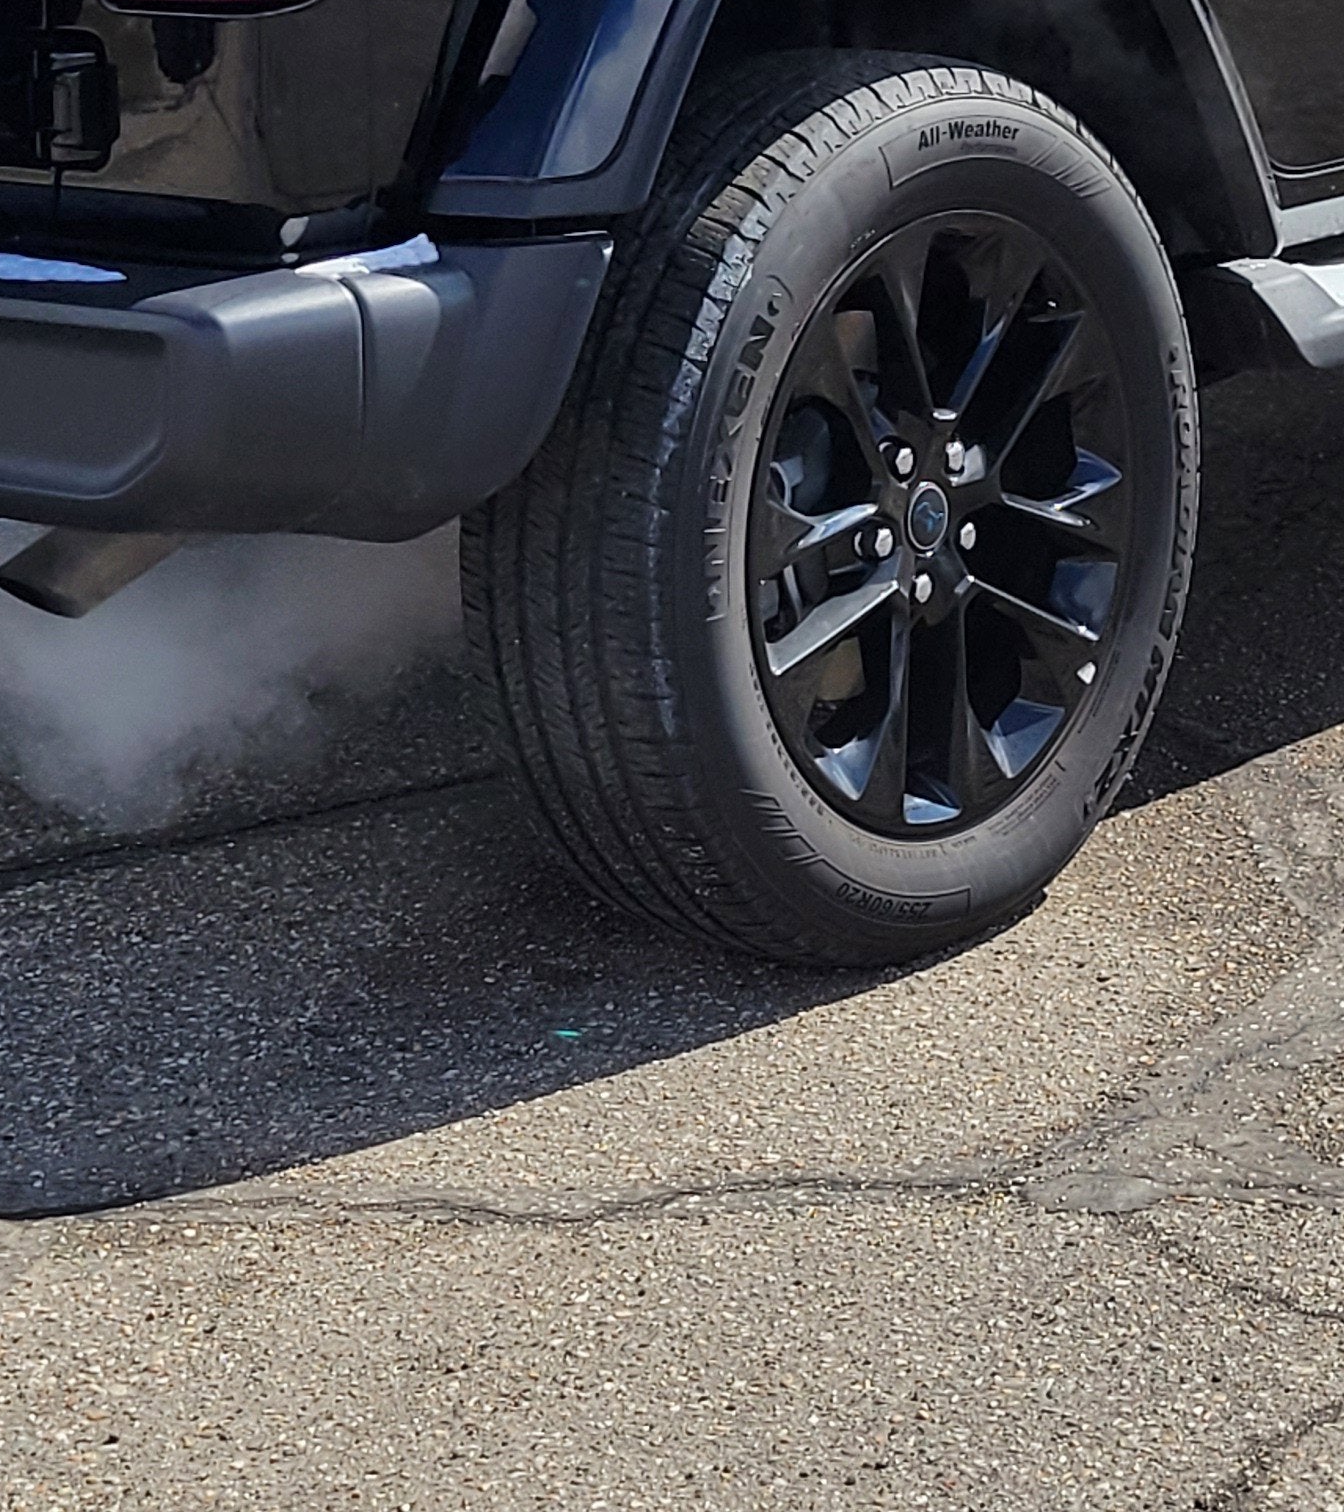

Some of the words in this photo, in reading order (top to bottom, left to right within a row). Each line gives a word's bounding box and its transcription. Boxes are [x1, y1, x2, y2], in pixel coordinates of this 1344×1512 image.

[918, 119, 1020, 151] All-Weather
[704, 313, 775, 569] NEXEN
[835, 882, 932, 920] 255/60R20
